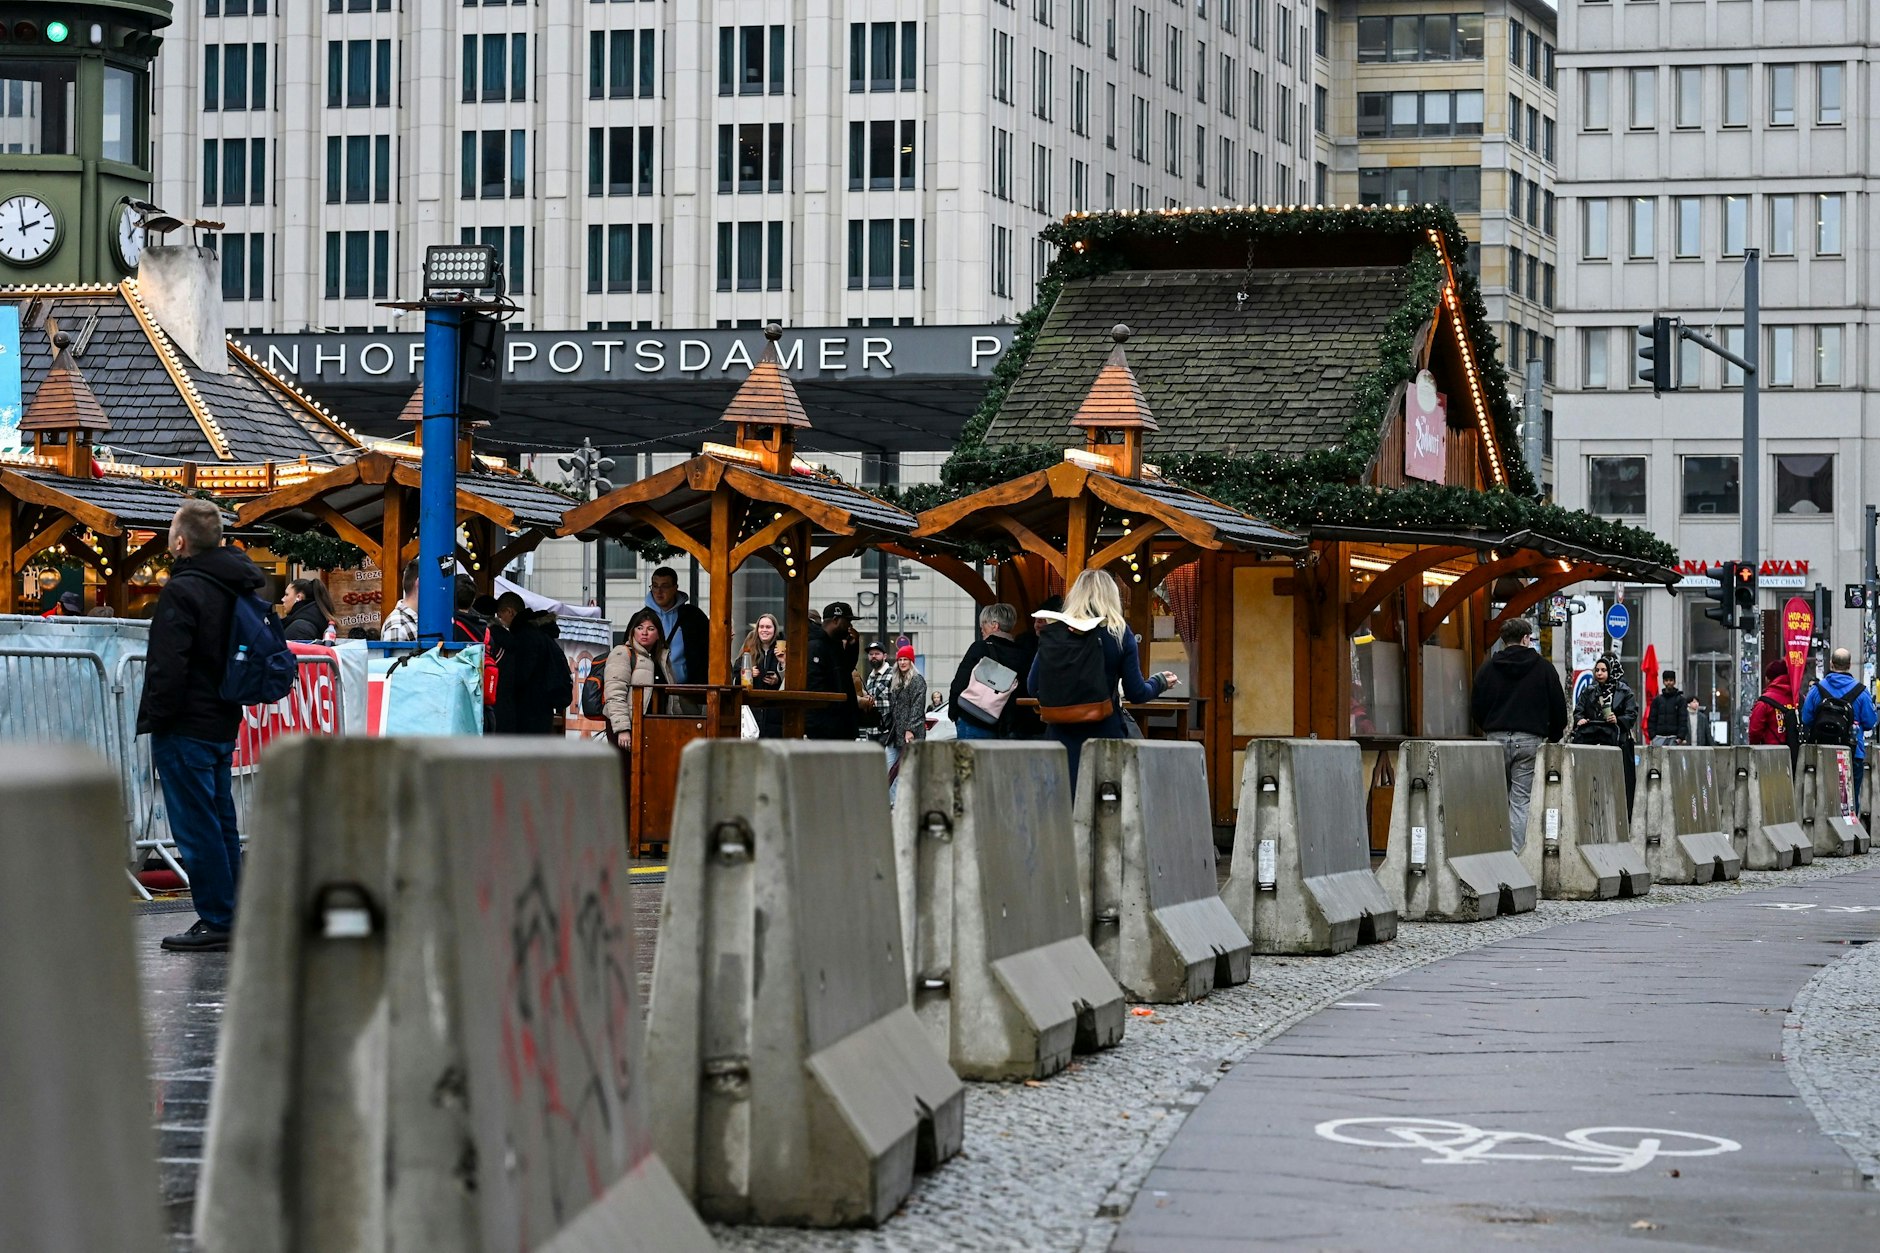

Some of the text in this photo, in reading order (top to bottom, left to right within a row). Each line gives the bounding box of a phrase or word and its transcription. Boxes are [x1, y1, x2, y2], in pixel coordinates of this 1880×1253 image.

[507, 336, 893, 373] POTSDAMER
[1759, 560, 1809, 575] AVAN
[1788, 612, 1811, 622] HOP-ON
[1788, 621, 1810, 631] HOP-OFF
